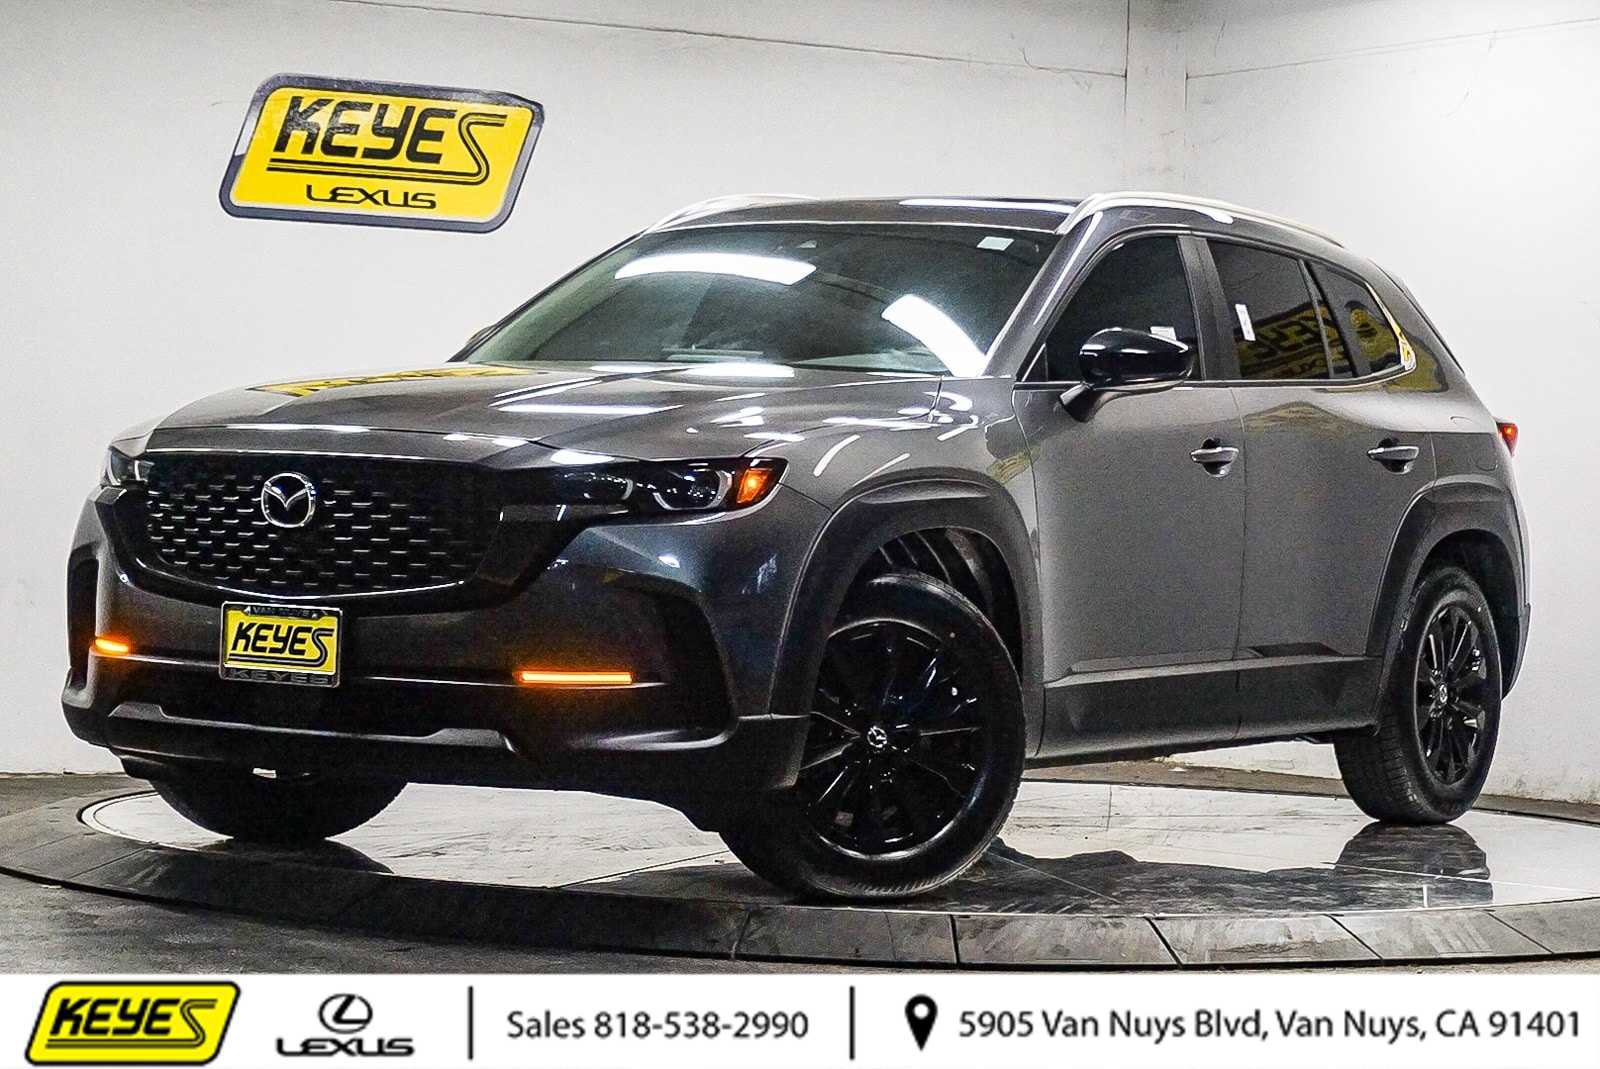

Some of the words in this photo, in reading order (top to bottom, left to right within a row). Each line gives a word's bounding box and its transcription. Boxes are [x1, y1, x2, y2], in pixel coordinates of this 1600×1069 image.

[268, 95, 507, 185] KEYES
[306, 184, 437, 209] LEXUS
[229, 621, 335, 667] KEYES
[231, 669, 329, 685] KEYES
